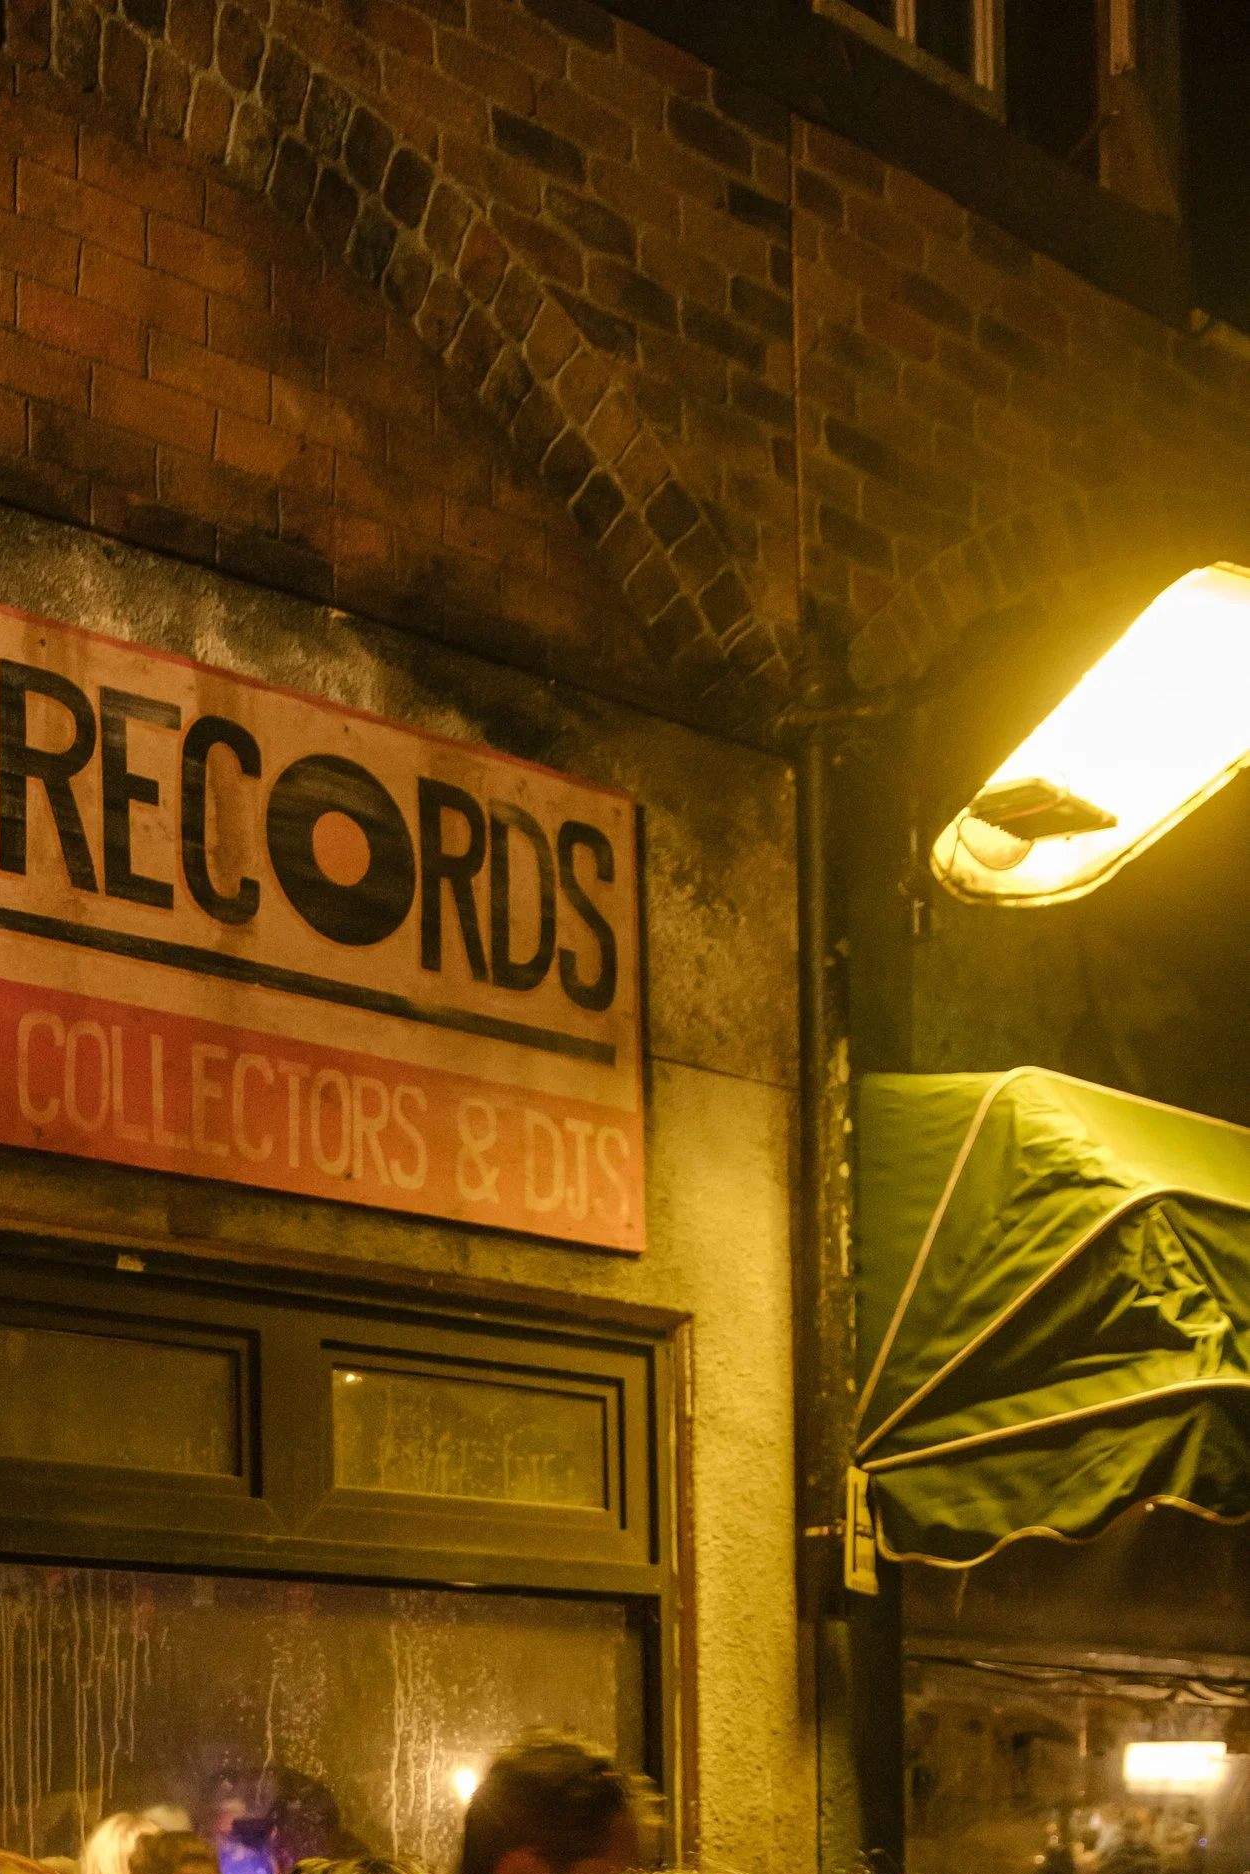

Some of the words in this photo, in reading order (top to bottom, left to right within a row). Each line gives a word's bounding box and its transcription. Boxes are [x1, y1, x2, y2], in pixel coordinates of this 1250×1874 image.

[16, 1010, 427, 1193] COLLECTORS
[456, 1097, 502, 1205] &
[523, 1109, 630, 1221] DJS
